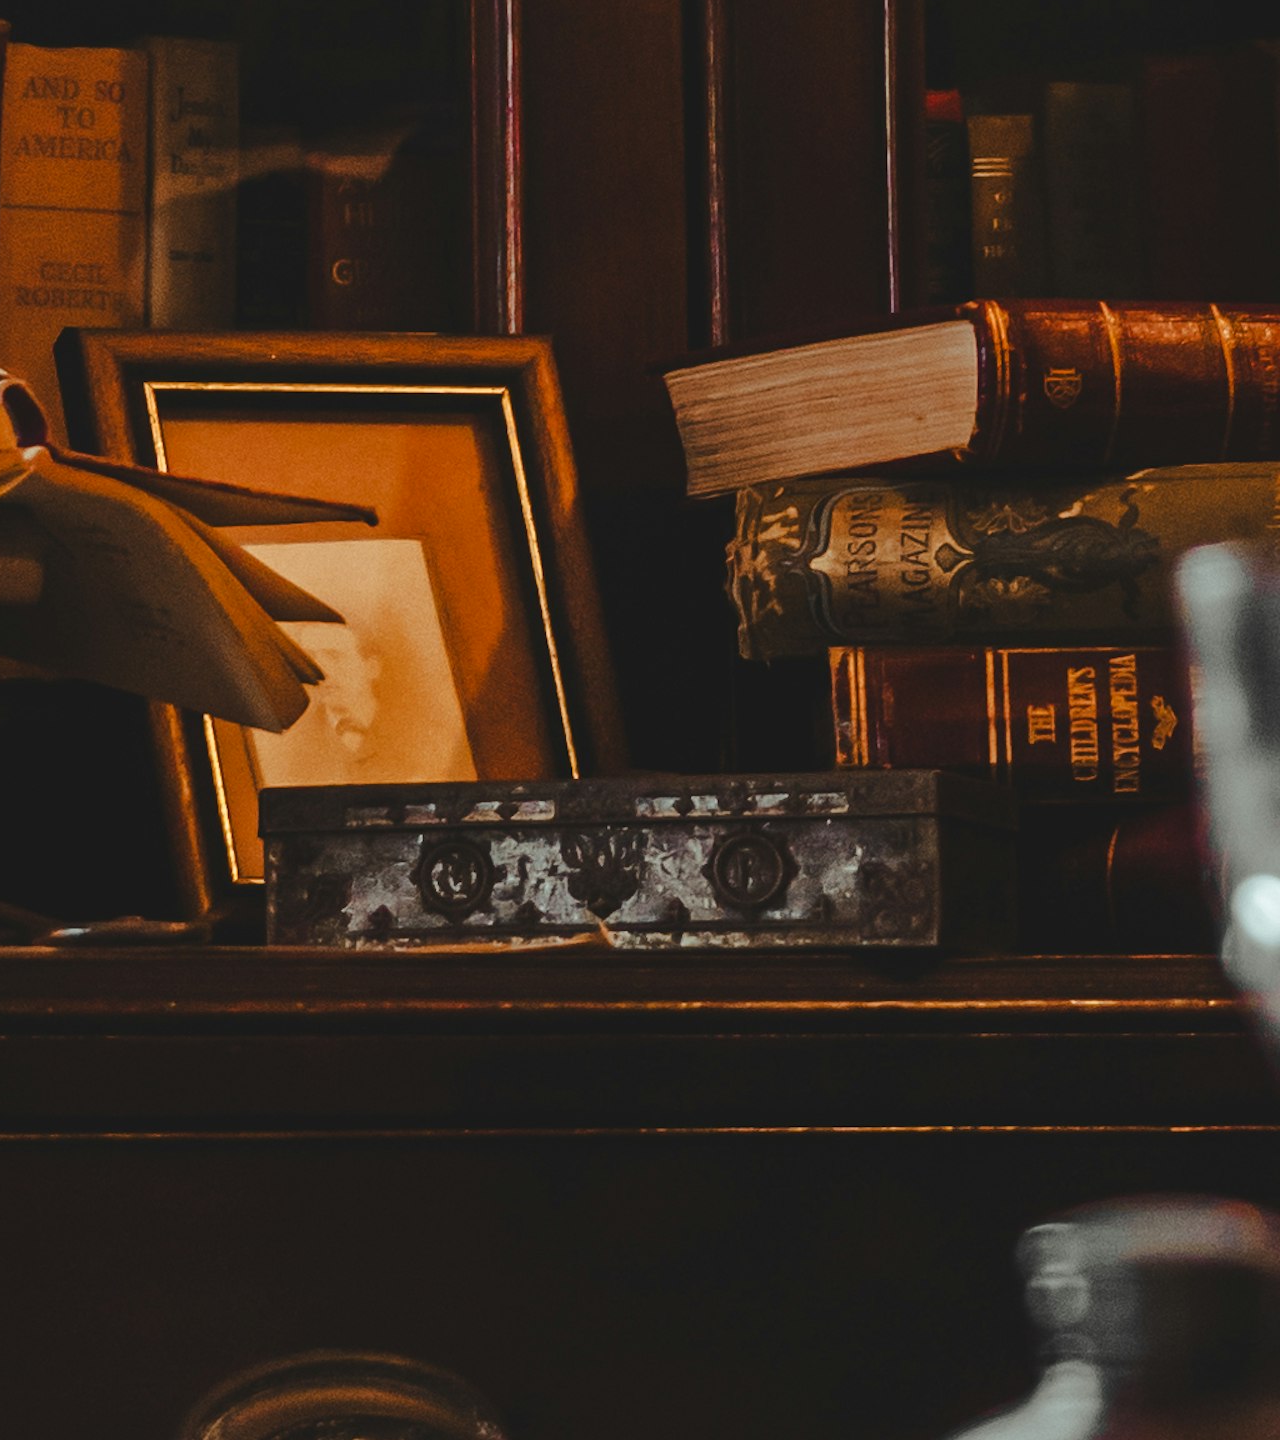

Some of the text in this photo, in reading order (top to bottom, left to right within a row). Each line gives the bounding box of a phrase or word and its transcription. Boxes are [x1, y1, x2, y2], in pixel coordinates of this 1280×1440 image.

[22, 76, 127, 104] AND SO
[56, 105, 97, 130] TO
[13, 134, 136, 164] AMERICA
[39, 260, 107, 285] CECIL
[15, 285, 128, 313] ROBERTS
[1026, 703, 1057, 746] THE
[1066, 665, 1100, 783] CHILDREN'S
[1108, 653, 1141, 795] ENCYCLOPEDIA
